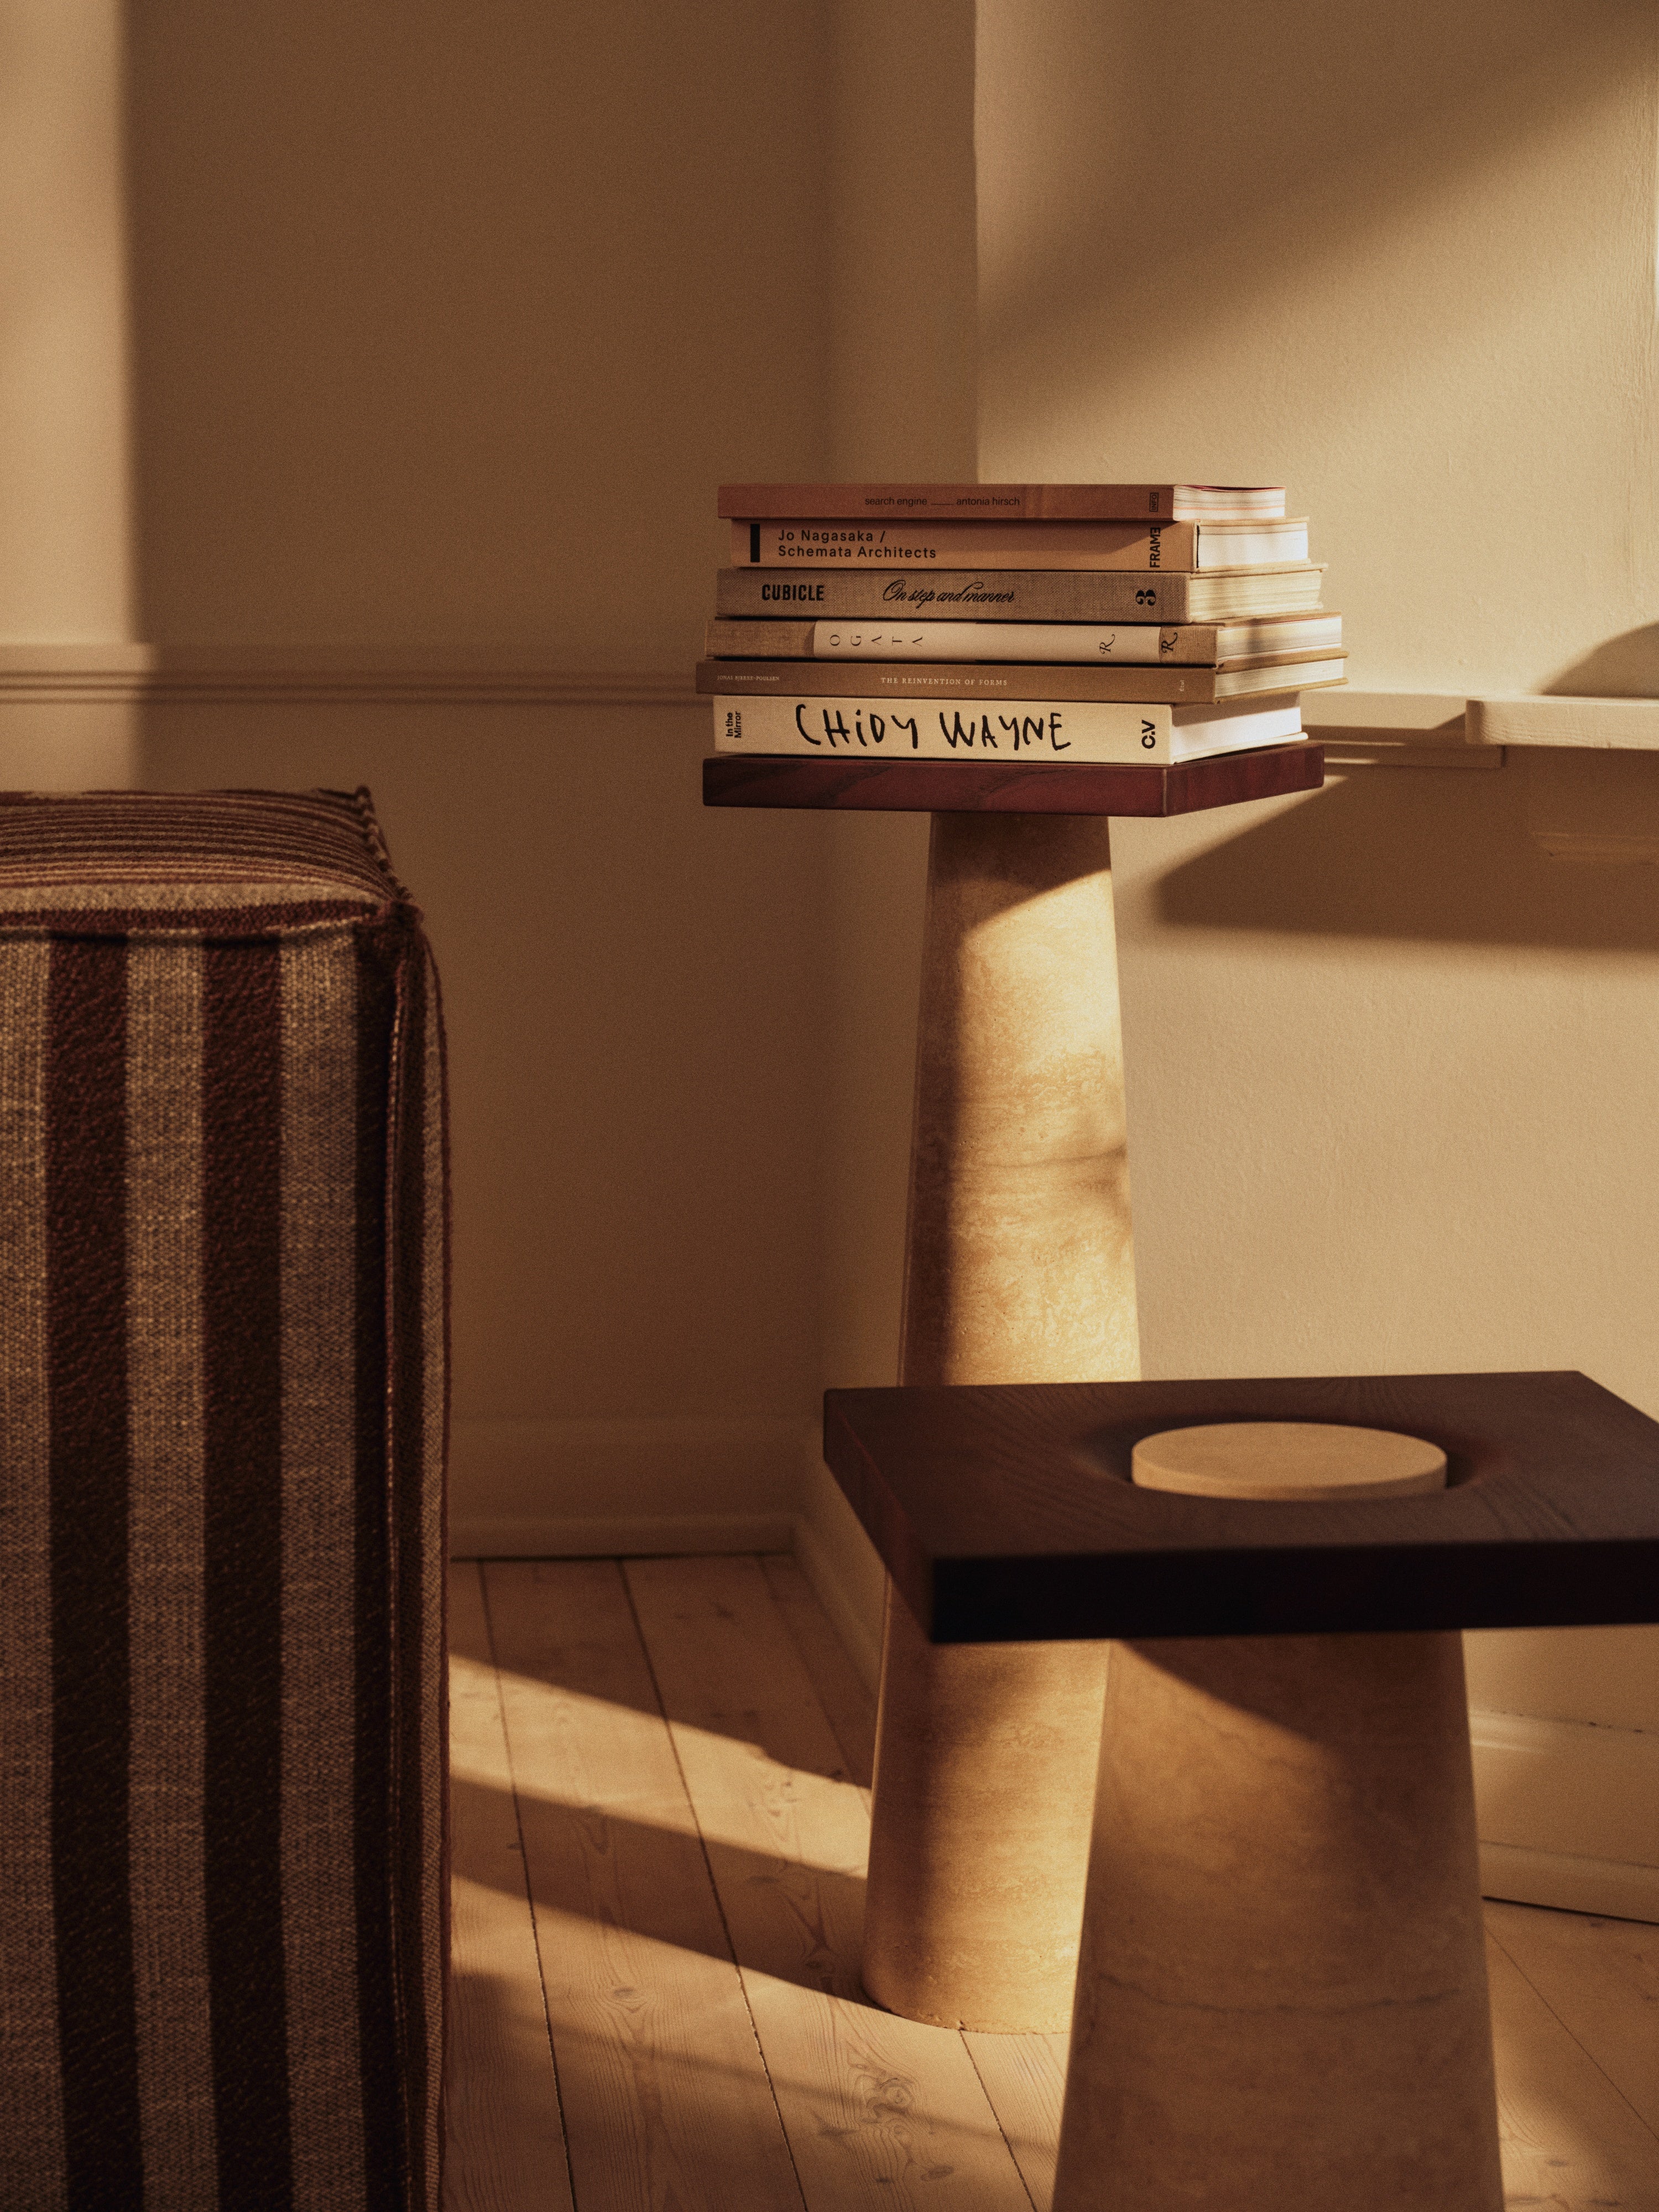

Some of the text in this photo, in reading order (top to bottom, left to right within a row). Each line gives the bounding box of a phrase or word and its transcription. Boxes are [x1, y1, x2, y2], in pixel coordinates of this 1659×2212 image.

[865, 497, 1020, 507] search engine antonia hirsch
[778, 529, 795, 541] Jo
[801, 529, 874, 544] Nagasaka
[778, 545, 936, 559] Schemata Architects
[761, 584, 824, 601] CUBICLE
[883, 580, 1015, 609] On step and manner
[1099, 634, 1115, 654] R
[1161, 632, 1178, 653] R
[726, 728, 733, 737] In
[940, 712, 1071, 750] WAYNE
